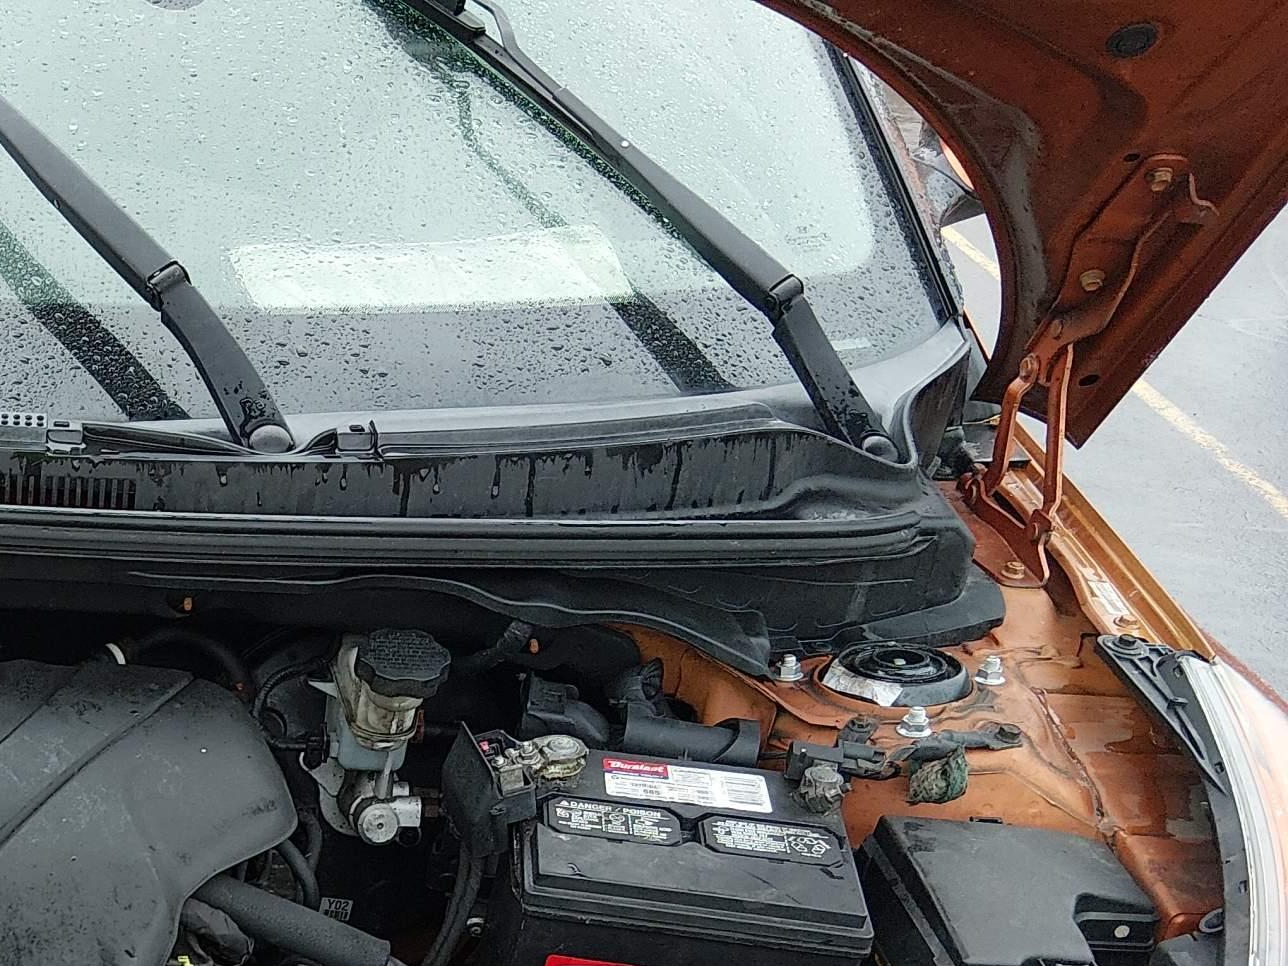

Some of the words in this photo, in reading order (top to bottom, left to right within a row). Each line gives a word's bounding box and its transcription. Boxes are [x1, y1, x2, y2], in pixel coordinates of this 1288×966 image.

[607, 760, 664, 773] Duralast
[570, 801, 612, 812] DANGER
[622, 807, 661, 818] POISON
